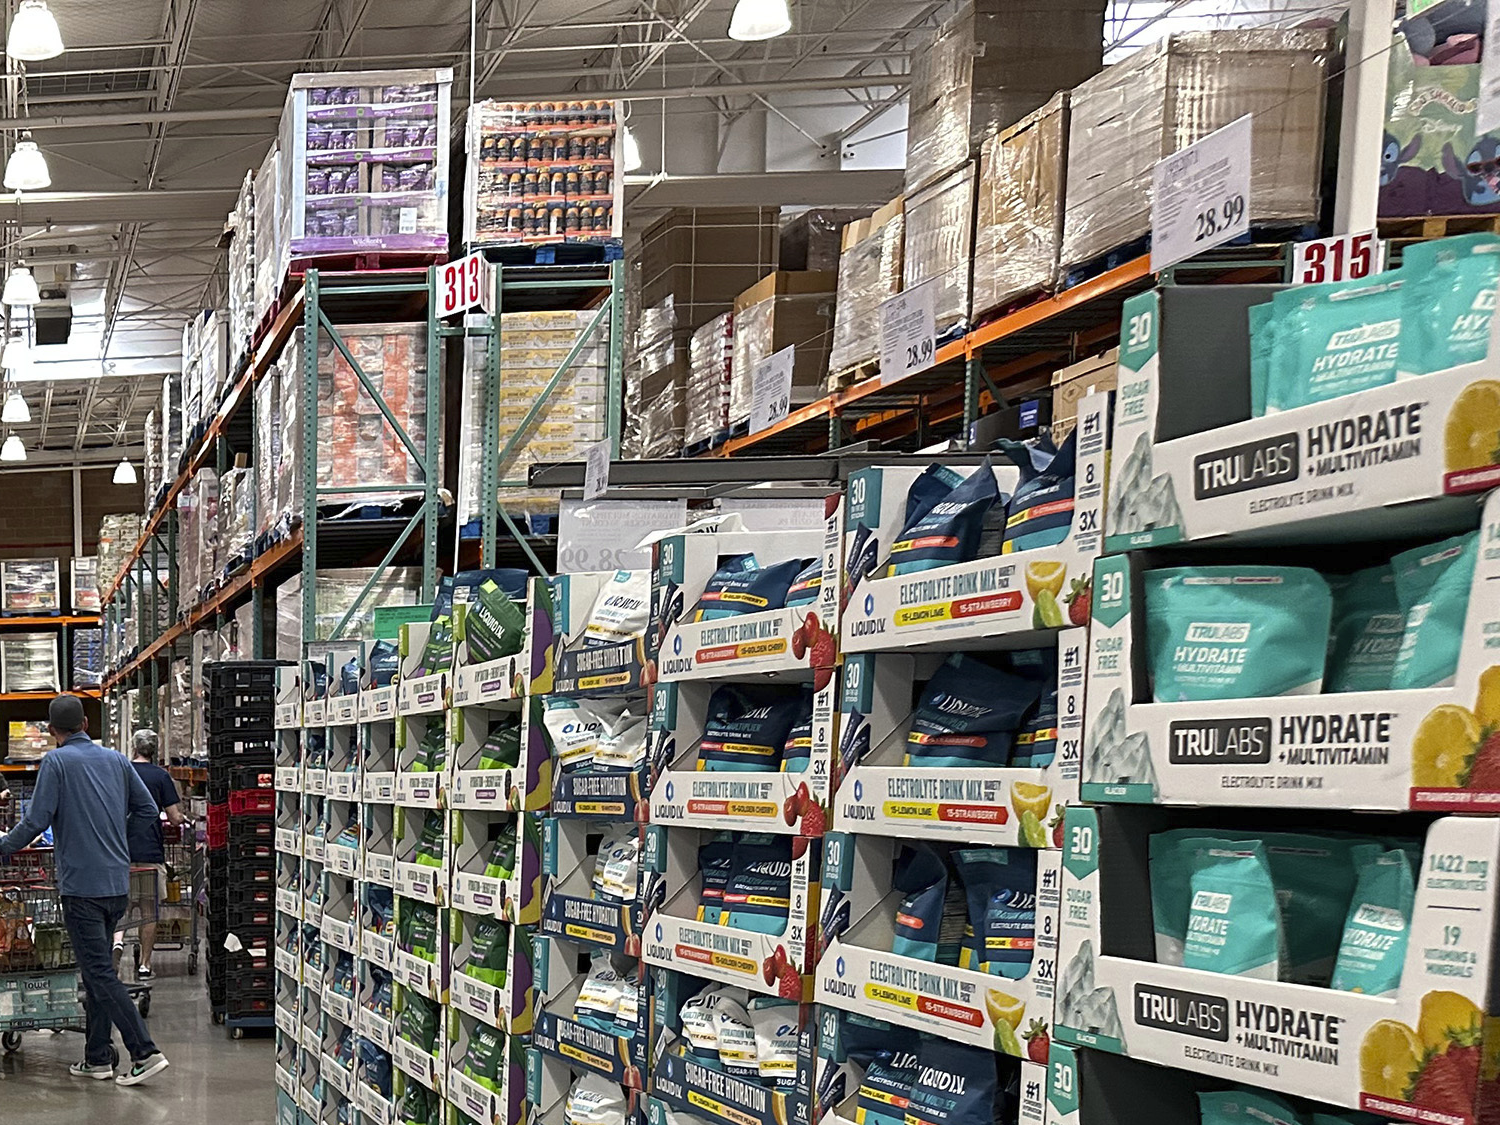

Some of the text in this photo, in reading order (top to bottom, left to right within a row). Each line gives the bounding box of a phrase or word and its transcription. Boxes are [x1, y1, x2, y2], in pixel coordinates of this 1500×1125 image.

[1194, 195, 1244, 242] 28.99
[1304, 234, 1373, 284] 315
[445, 257, 479, 311] 313
[1128, 312, 1151, 345] 30
[906, 339, 932, 369] 28.99
[1122, 380, 1149, 400] SUGAR
[768, 397, 788, 422] 28.99
[1123, 399, 1144, 415] FREE
[1307, 403, 1422, 458] HYDRATE
[1199, 442, 1292, 492] TRULABS
[851, 477, 866, 503] 30
[1249, 491, 1303, 515] ELECTROLYTE
[1337, 482, 1354, 498] MIX
[1080, 509, 1097, 530] 3X
[900, 570, 996, 605] ELECTROLYTE DRINK MIX
[959, 598, 1012, 614] 15-STRAWBERRY
[851, 619, 874, 637] LIQUID
[1174, 646, 1248, 665] HYDRATE
[1174, 726, 1263, 757] TRULABS
[1279, 713, 1390, 745] HYDRATE
[1071, 827, 1091, 854] 30
[1430, 853, 1489, 879] 1422 mg
[1066, 888, 1091, 905] SUGAR
[1069, 905, 1088, 920] FREE
[1443, 926, 1461, 944] 19
[1139, 991, 1222, 1033] TRULABS
[1236, 1001, 1340, 1045] HYDRATE
[685, 1062, 766, 1113] SUGAR-FREE HYDRATION
[1365, 1098, 1418, 1118] STRAWBERRY
